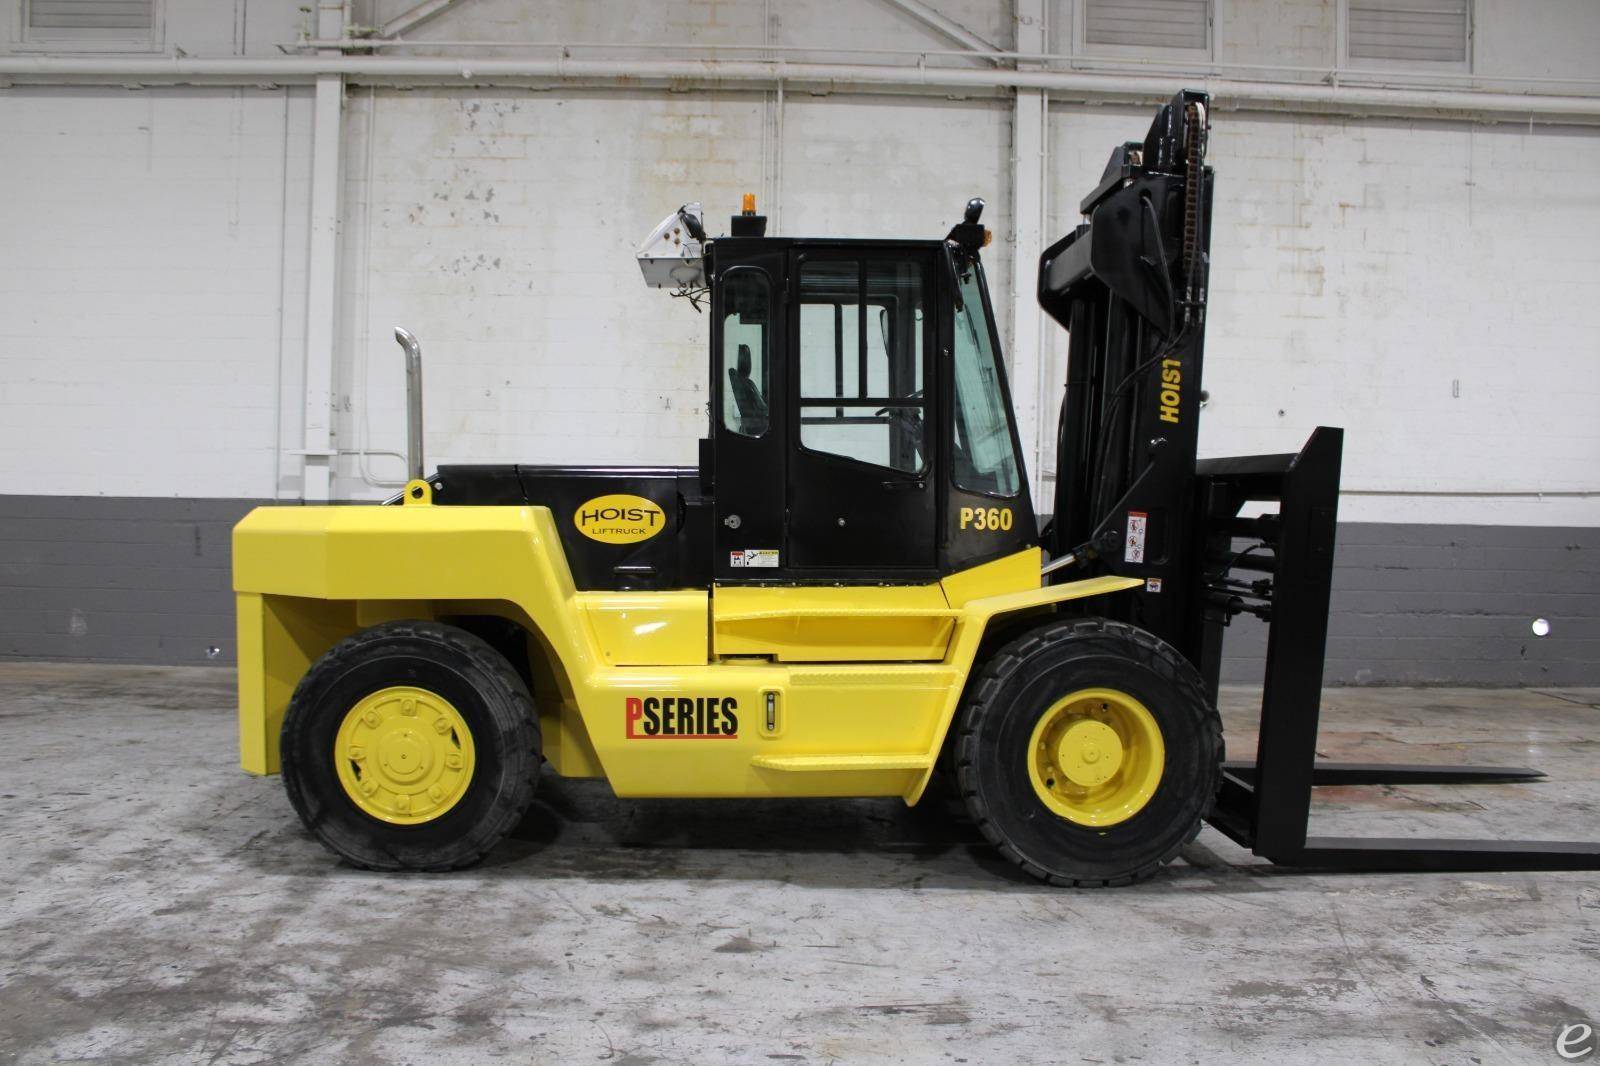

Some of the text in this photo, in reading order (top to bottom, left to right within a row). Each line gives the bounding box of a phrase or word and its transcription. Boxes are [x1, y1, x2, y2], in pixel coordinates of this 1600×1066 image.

[1160, 359, 1181, 423] HOIST
[582, 508, 660, 526] HOIST
[960, 507, 1013, 531] P360
